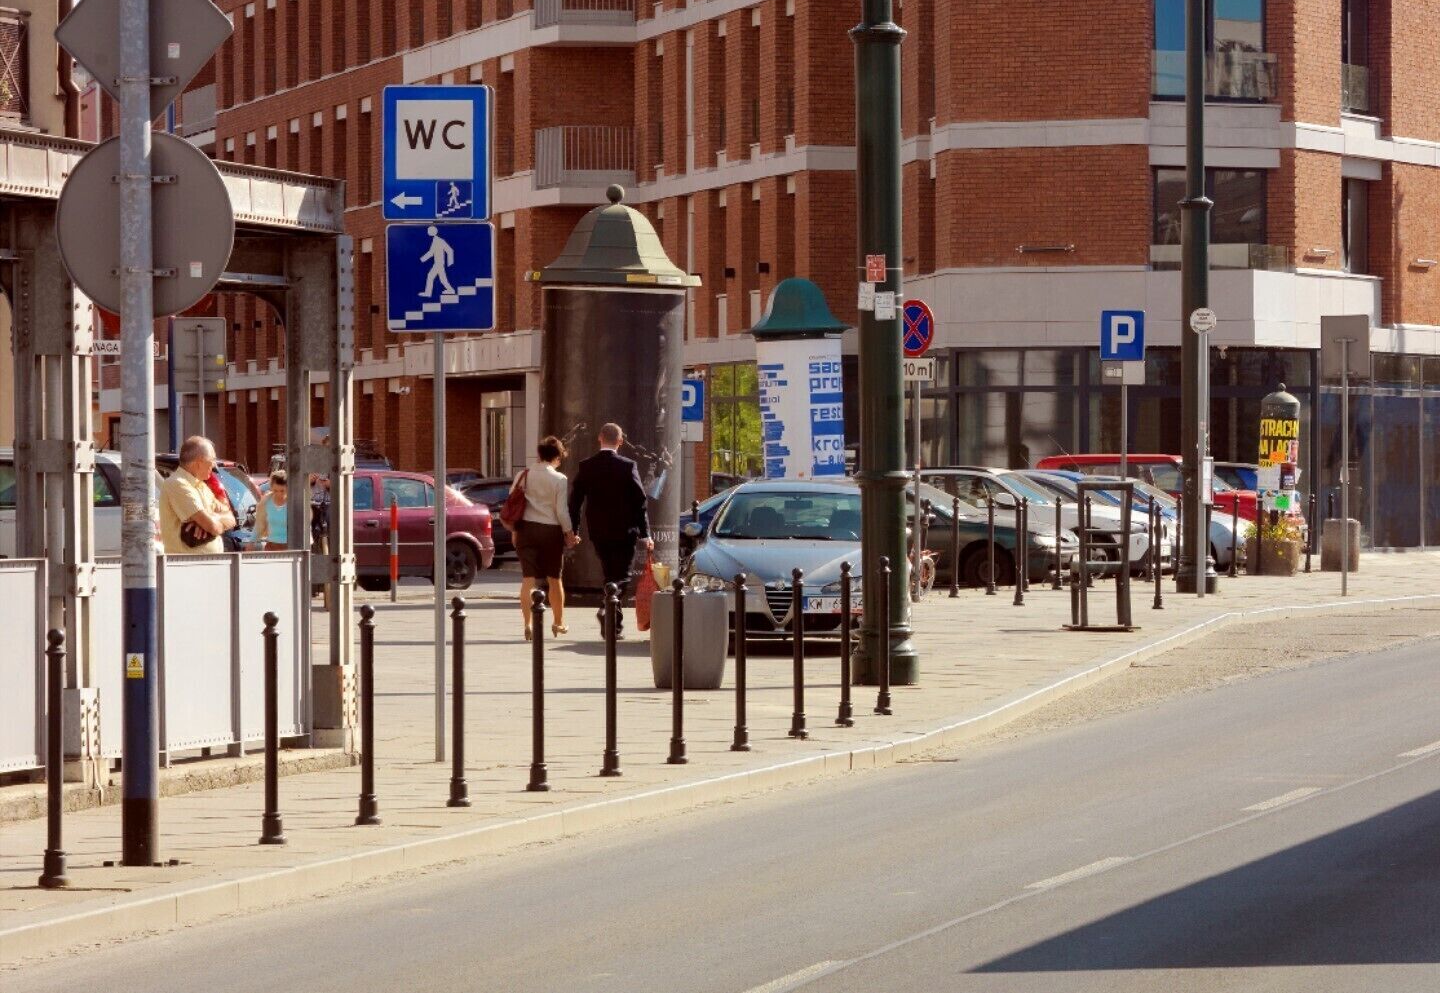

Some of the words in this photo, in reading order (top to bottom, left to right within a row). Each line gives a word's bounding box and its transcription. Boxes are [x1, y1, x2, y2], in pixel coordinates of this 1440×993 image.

[404, 119, 466, 149] WC
[1111, 316, 1136, 354] P
[904, 363, 915, 375] 10
[917, 367, 928, 375] m
